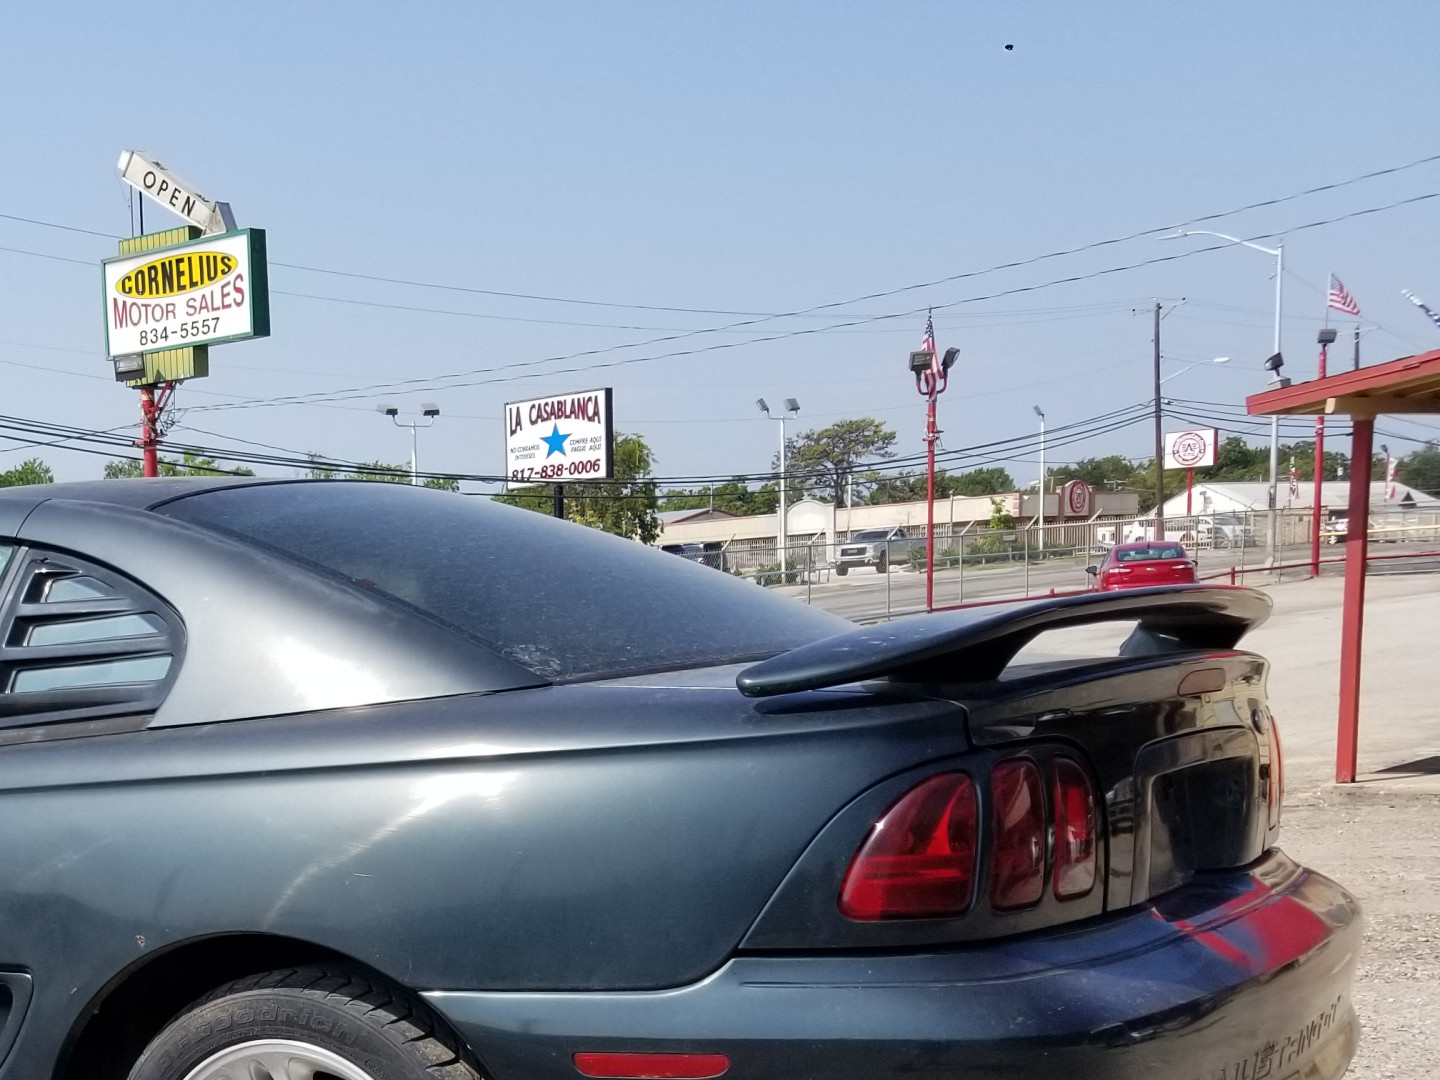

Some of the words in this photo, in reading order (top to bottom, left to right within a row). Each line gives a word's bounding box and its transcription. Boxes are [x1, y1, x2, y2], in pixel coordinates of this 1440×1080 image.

[143, 171, 196, 217] OPEN
[121, 254, 233, 295] CORNELIUS
[113, 297, 177, 330] MOTOR
[186, 273, 246, 318] SALES
[139, 316, 221, 346] 834-5557
[509, 406, 523, 438] LA
[528, 395, 601, 426] CASABLANCA
[511, 458, 601, 481] 817-838-0006
